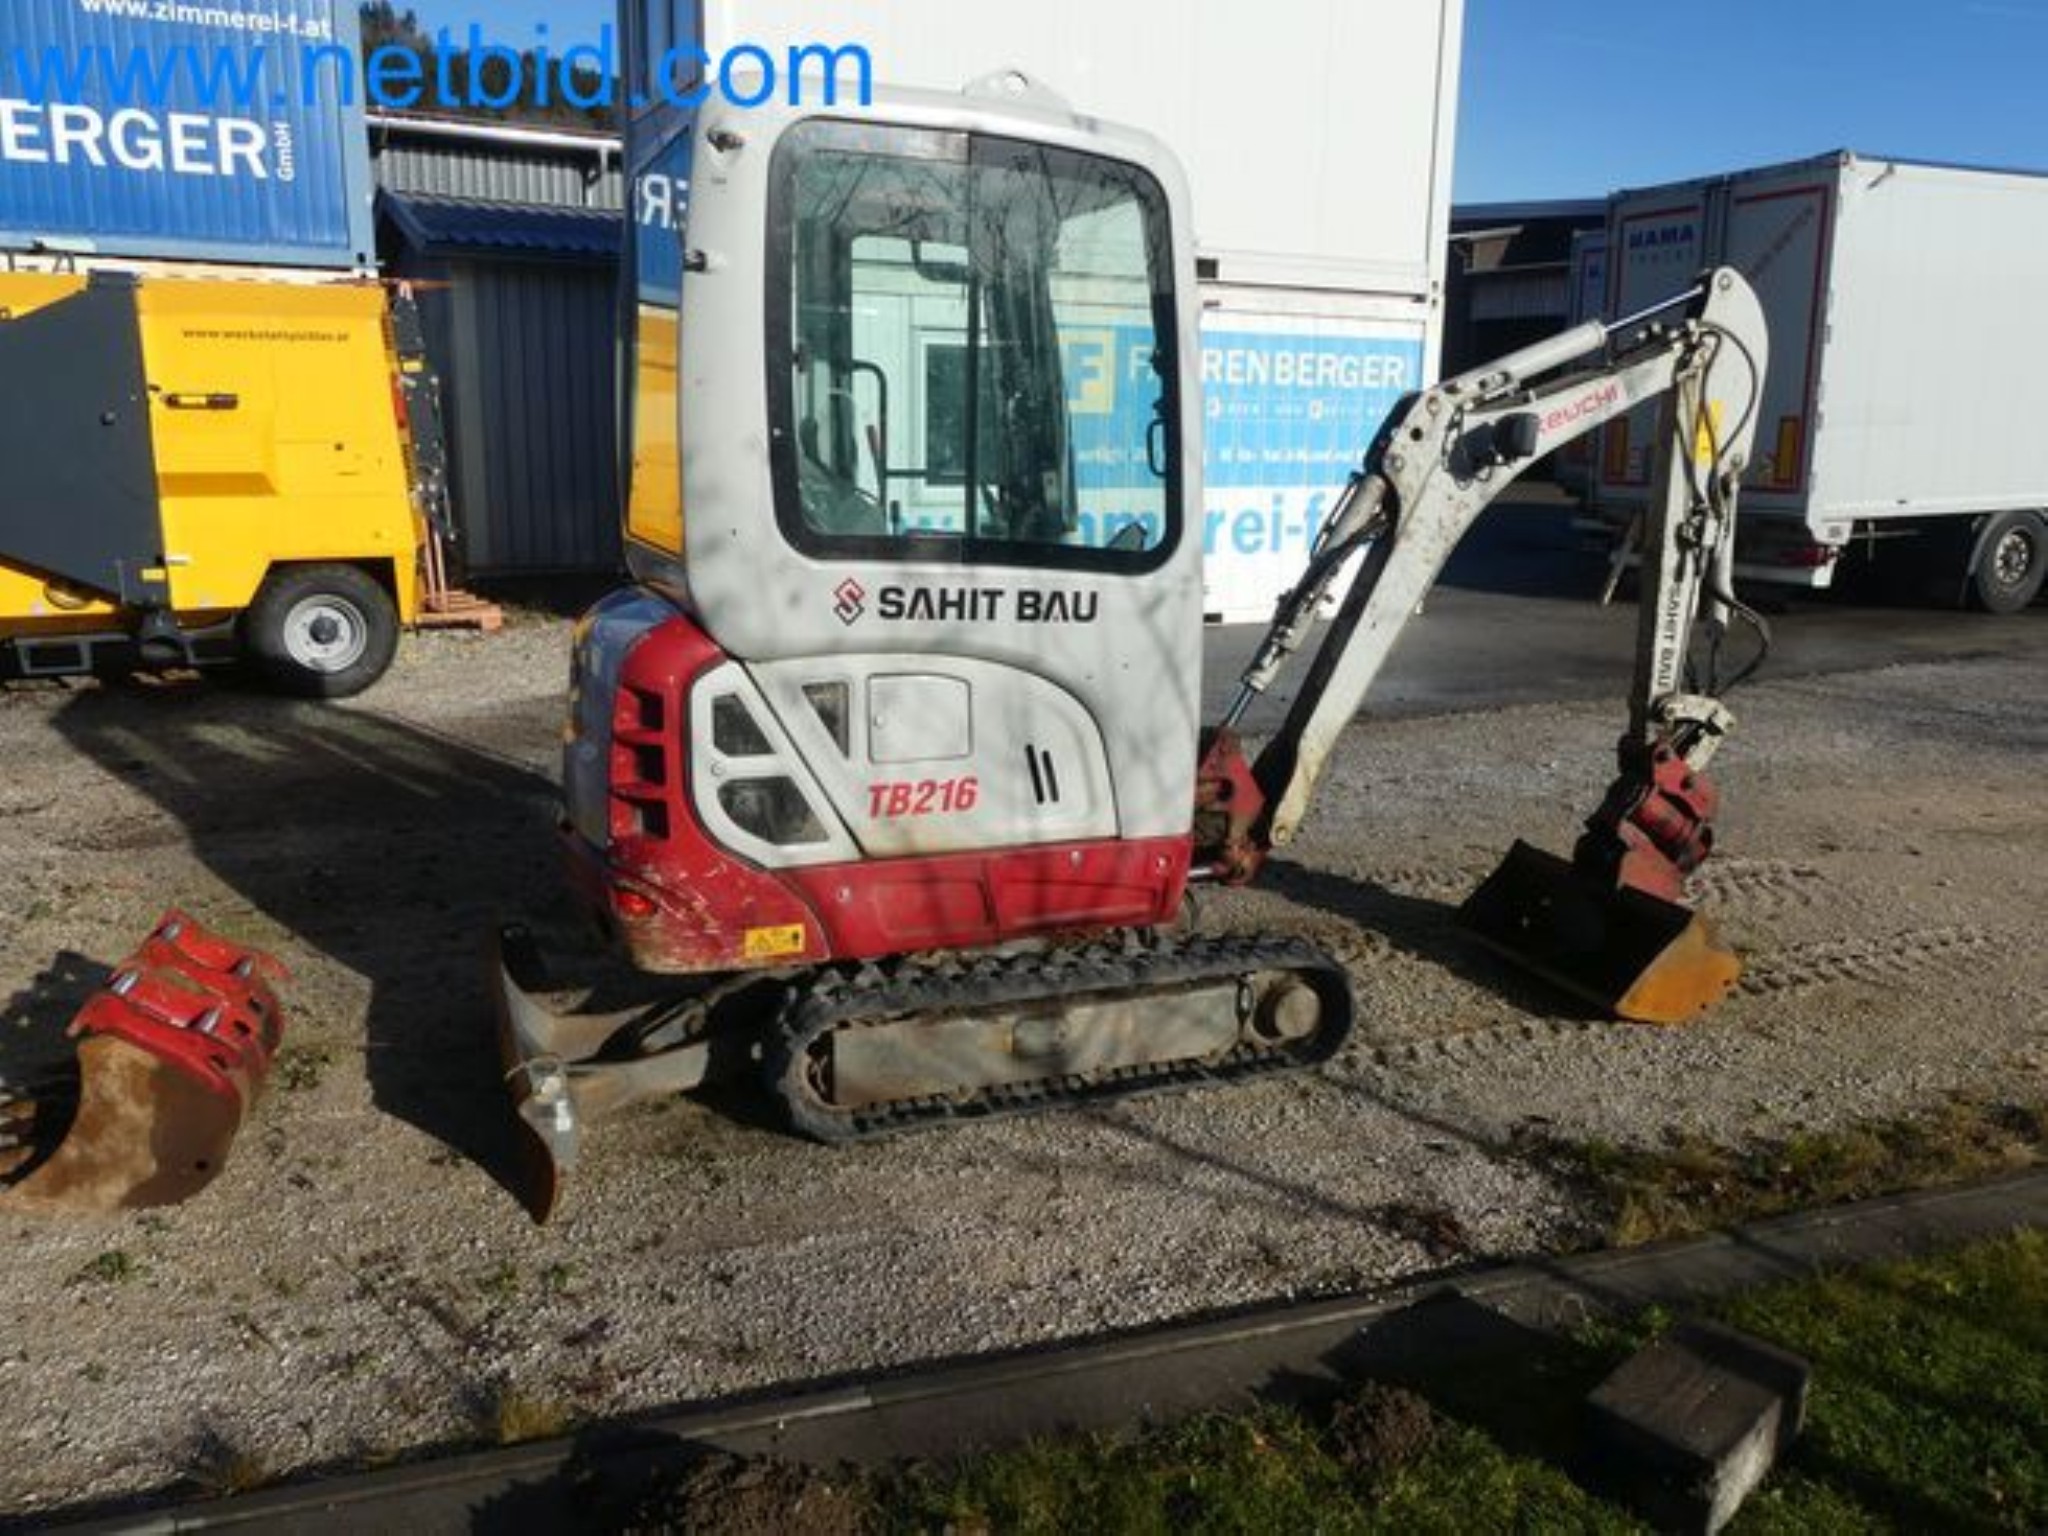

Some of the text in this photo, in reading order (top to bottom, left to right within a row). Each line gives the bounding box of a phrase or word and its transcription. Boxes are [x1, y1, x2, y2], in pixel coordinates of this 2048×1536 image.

[274, 122, 294, 182] GmbH
[878, 586, 1099, 623] SAHIT BAU
[868, 777, 979, 820] TB216
